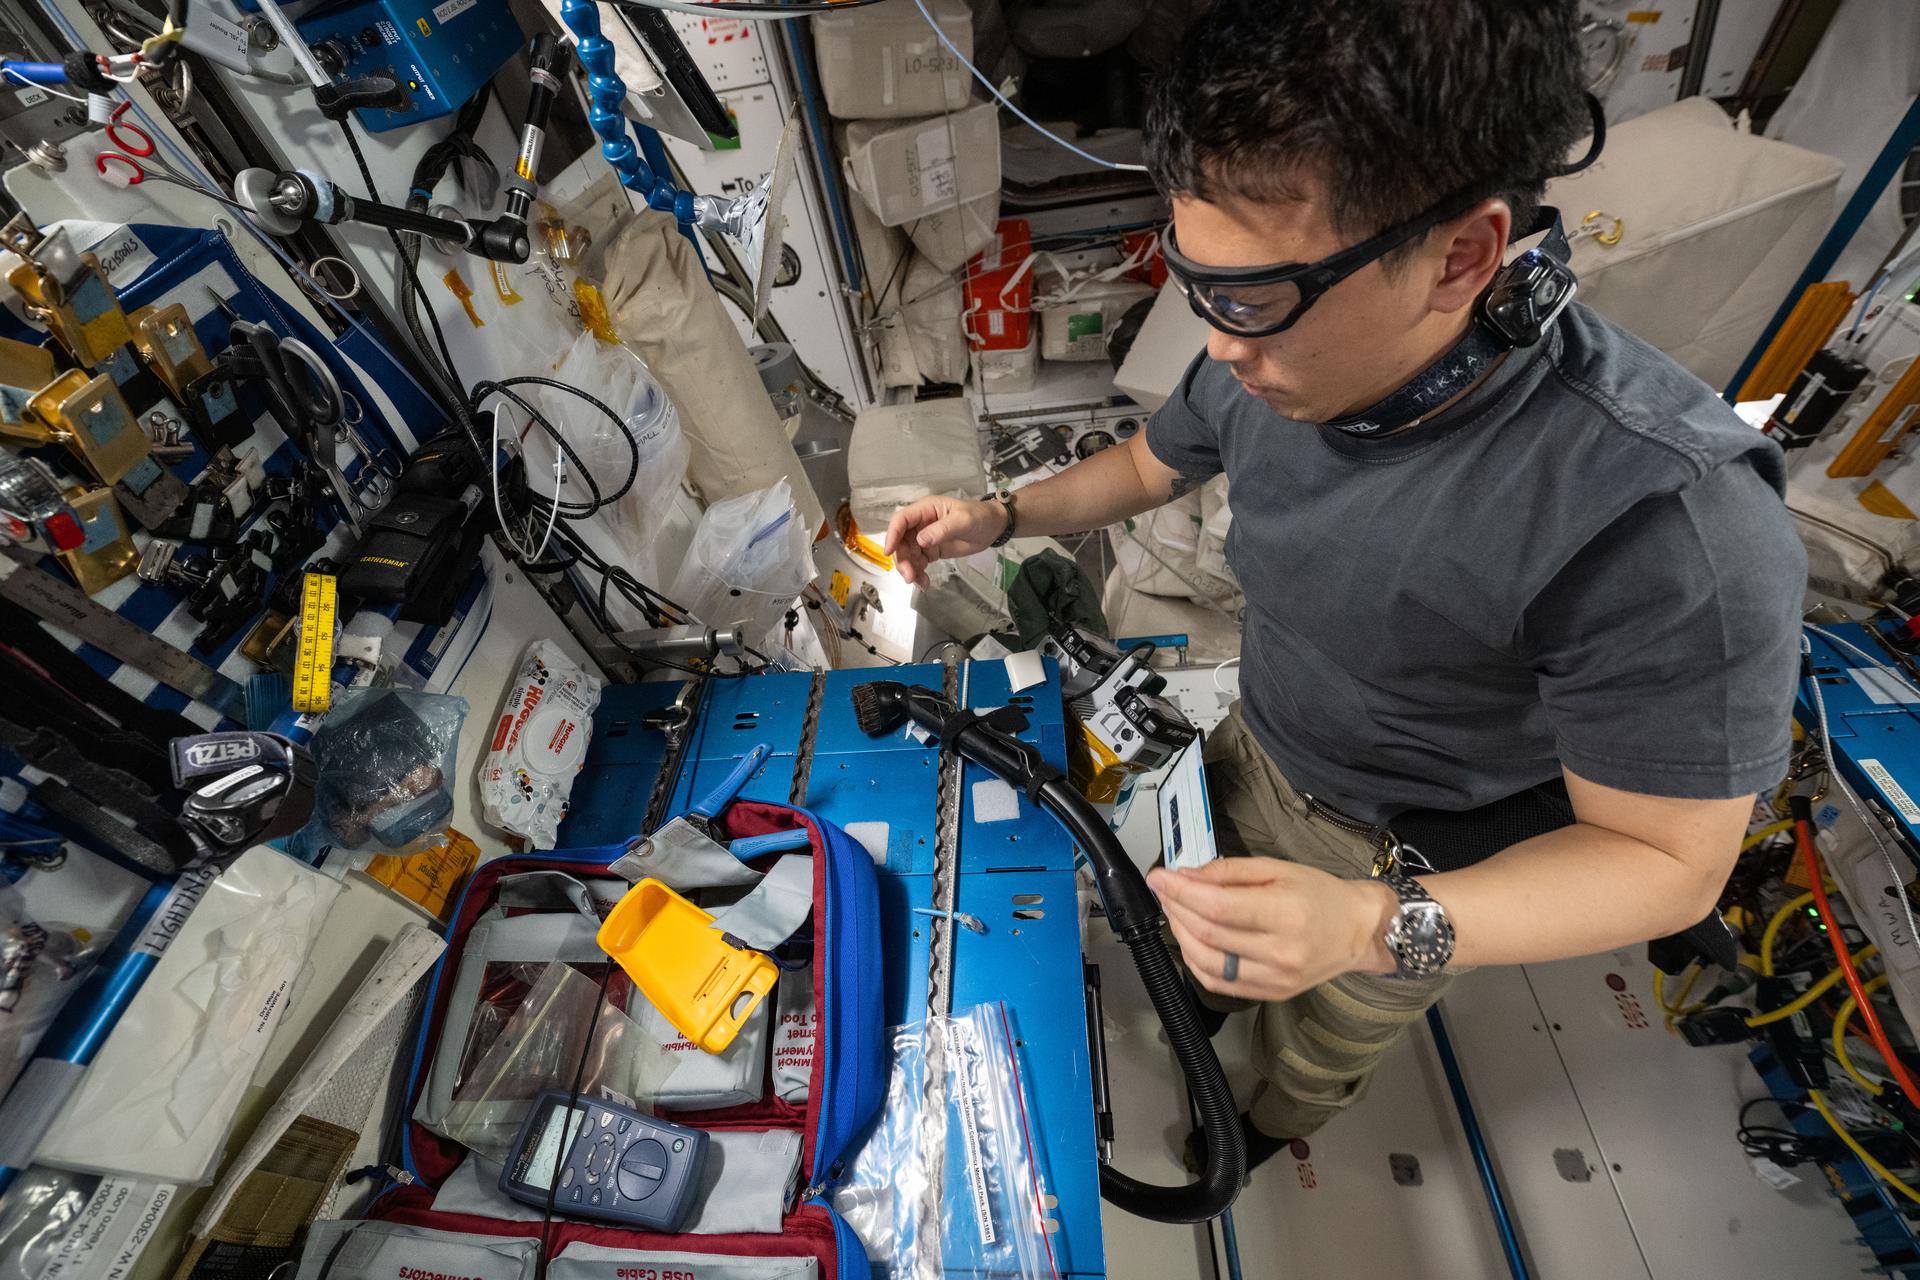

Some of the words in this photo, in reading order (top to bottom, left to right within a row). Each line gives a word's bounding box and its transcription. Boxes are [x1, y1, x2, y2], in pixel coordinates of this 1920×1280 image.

[410, 64, 425, 84] OUTPUT
[734, 176, 754, 193] To
[1413, 353, 1478, 404] TIKKA
[512, 686, 524, 709] simply
[506, 684, 544, 755] HUGGIES
[555, 722, 576, 755] HUGGIES
[144, 870, 215, 952] LIGHTING
[259, 1006, 268, 1018] Dry
[265, 990, 276, 1005] Wipe
[257, 1021, 265, 1033] P/N
[779, 1014, 808, 1026] Tool
[974, 1167, 984, 1191] Medical
[82, 1215, 112, 1251] Velcro
[106, 1187, 129, 1214] Loop
[616, 1268, 659, 1280] Cable
